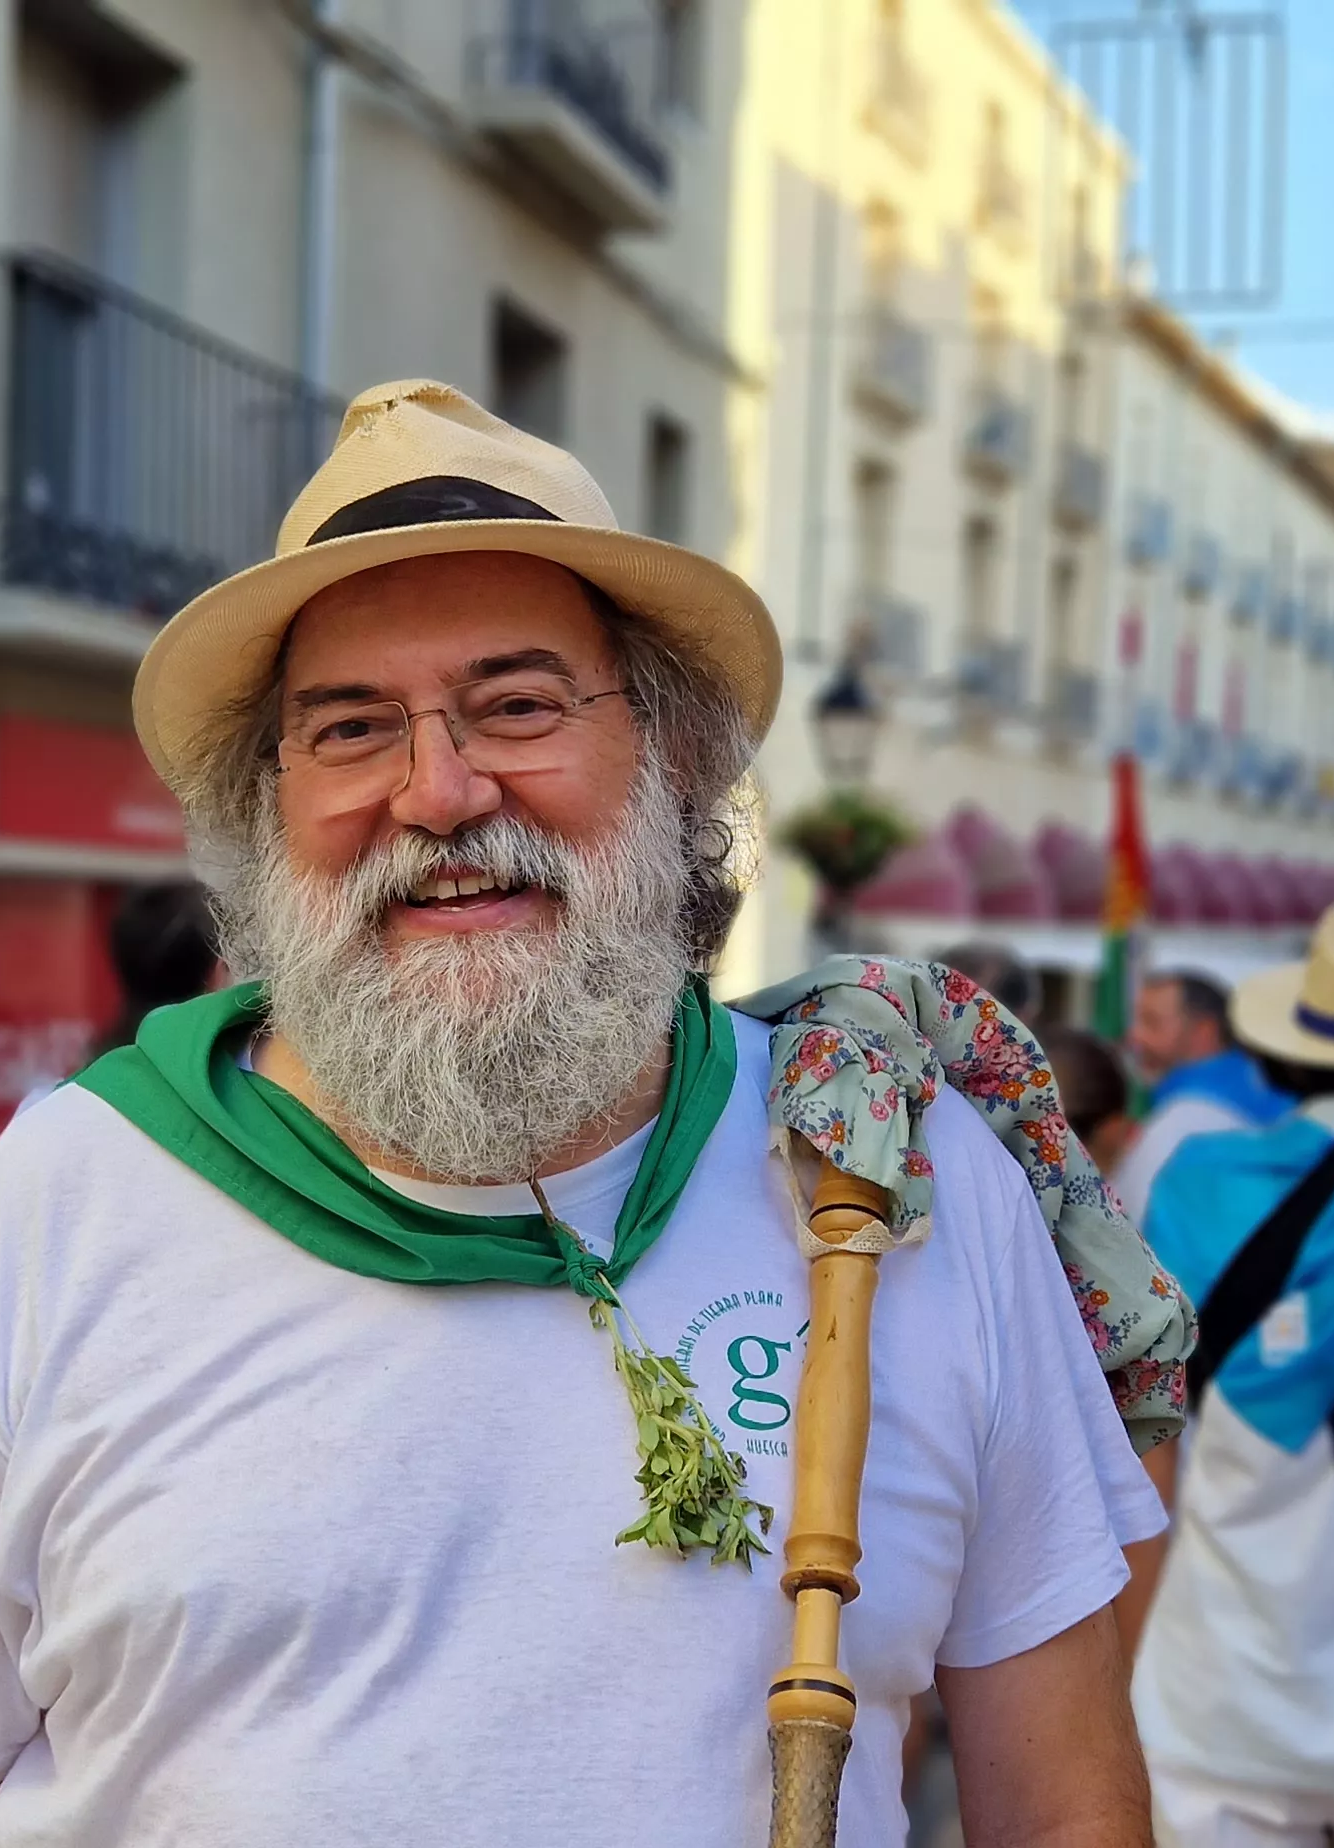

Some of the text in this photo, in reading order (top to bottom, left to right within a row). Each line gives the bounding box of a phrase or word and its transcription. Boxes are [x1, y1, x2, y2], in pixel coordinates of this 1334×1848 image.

[687, 1318, 707, 1337] DE
[698, 1293, 742, 1323] TIERRA
[743, 1290, 783, 1308] PLANA
[747, 1438, 789, 1457] HUESCA
